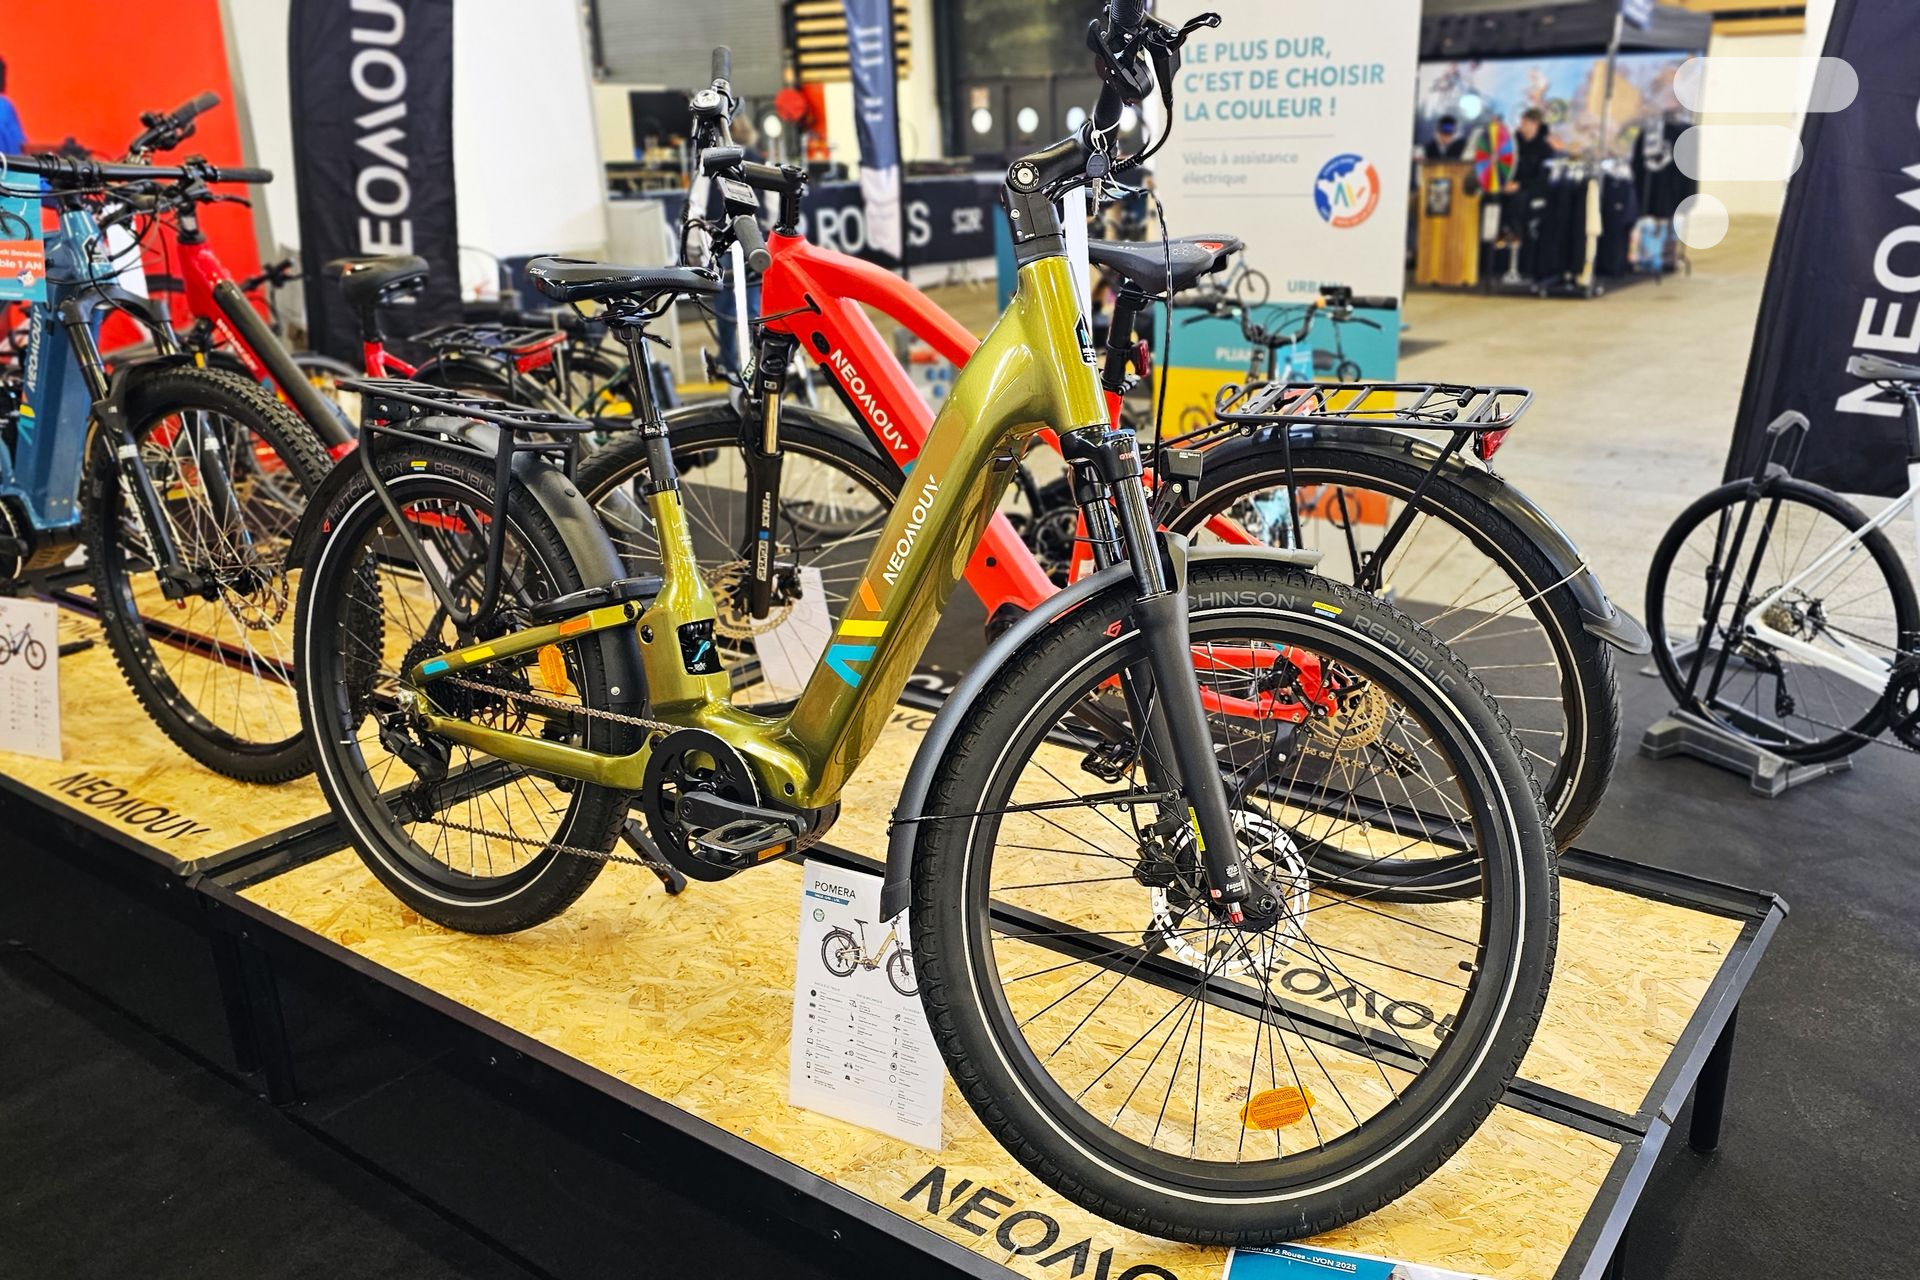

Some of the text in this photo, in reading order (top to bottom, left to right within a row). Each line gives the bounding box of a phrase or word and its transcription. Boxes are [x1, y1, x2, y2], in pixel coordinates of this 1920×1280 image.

[1184, 36, 1331, 64] LE PLUS DUR,
[1184, 64, 1385, 93] C'EST DE CHOISIR
[1183, 102, 1210, 121] LA
[1215, 97, 1322, 120] COULEUR
[350, 0, 414, 257] EOMOU
[1231, 151, 1299, 165] assistance
[1182, 171, 1248, 187] électrique
[830, 349, 909, 450] NEOMOUY
[882, 473, 940, 586] NEOMOUY
[1351, 614, 1457, 692] REPUBLIC
[49, 772, 212, 840] NEOMOUY
[815, 880, 856, 899] POMERA
[1281, 1250, 1306, 1260] Roues
[1312, 1256, 1335, 1267] LYON
[1335, 1261, 1357, 1271] 2025
